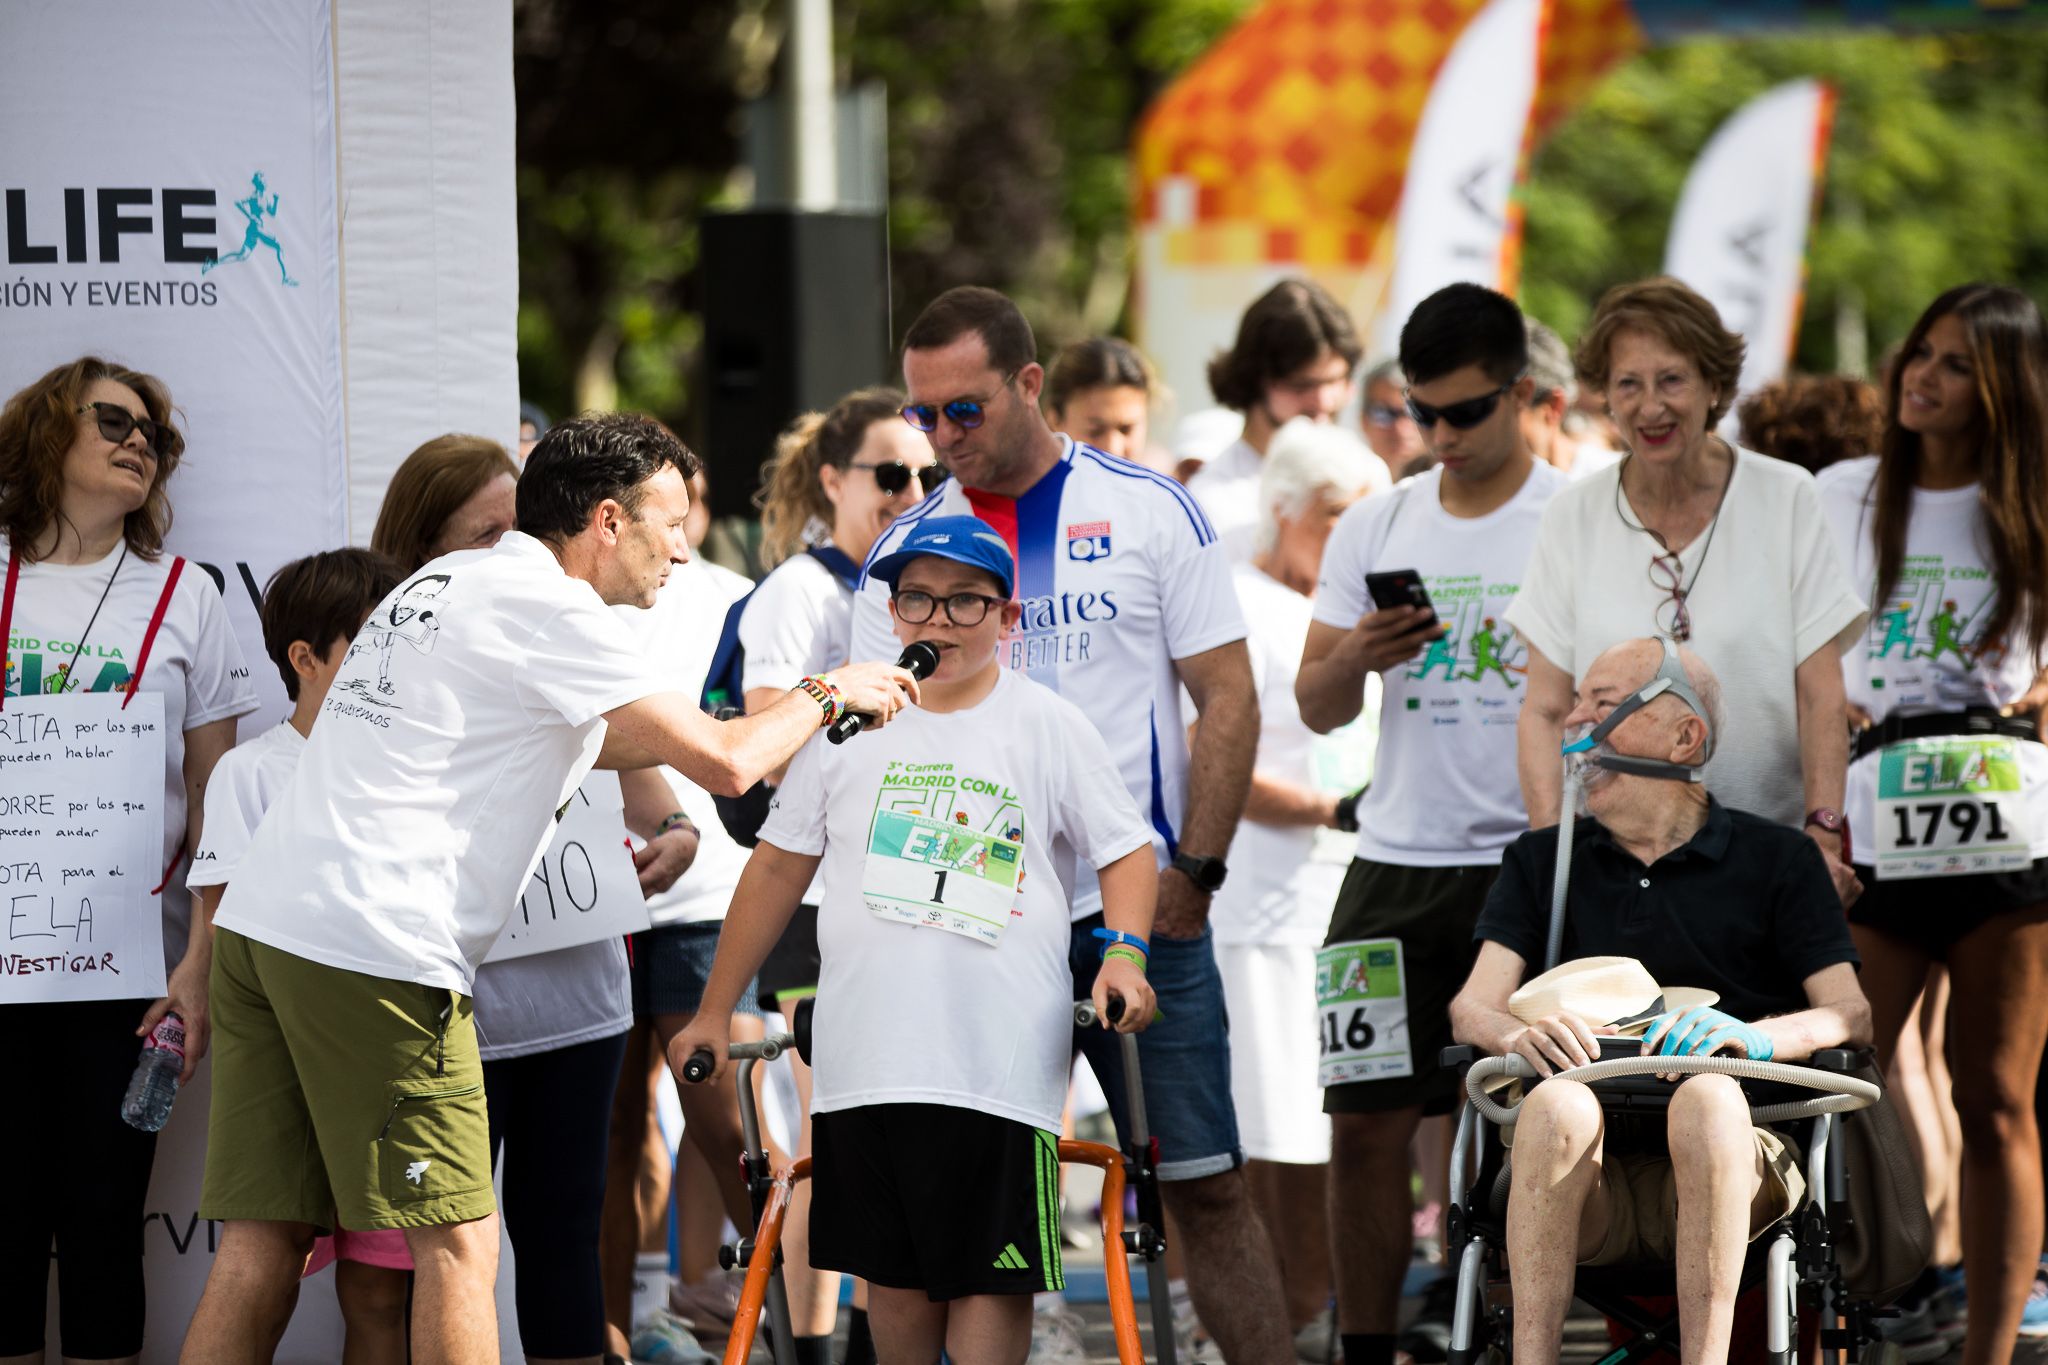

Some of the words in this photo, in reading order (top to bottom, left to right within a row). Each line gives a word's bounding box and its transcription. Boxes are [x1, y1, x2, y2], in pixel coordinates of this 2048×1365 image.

[6, 187, 218, 264] LIFE
[0, 276, 52, 307] IÓN
[62, 281, 79, 306] Y
[87, 281, 218, 306] EVENTOS
[46, 640, 92, 656] CON
[98, 645, 124, 660] LA
[1011, 631, 1092, 670] BETTER
[74, 723, 99, 740] por
[107, 718, 127, 734] los
[131, 723, 157, 739] que
[65, 745, 115, 760] hablar
[904, 763, 955, 773] Carrera
[1903, 750, 1990, 793] ELA
[882, 773, 956, 788] MADRID
[960, 777, 999, 797] CON
[68, 802, 89, 819] por
[97, 796, 115, 810] los
[122, 802, 146, 816] que
[55, 826, 99, 838] andar
[1893, 800, 2009, 848] 1791
[900, 825, 987, 879] ELA
[61, 867, 97, 887] para
[108, 864, 125, 878] el
[930, 870, 948, 904] 1
[9, 894, 94, 943] ELA
